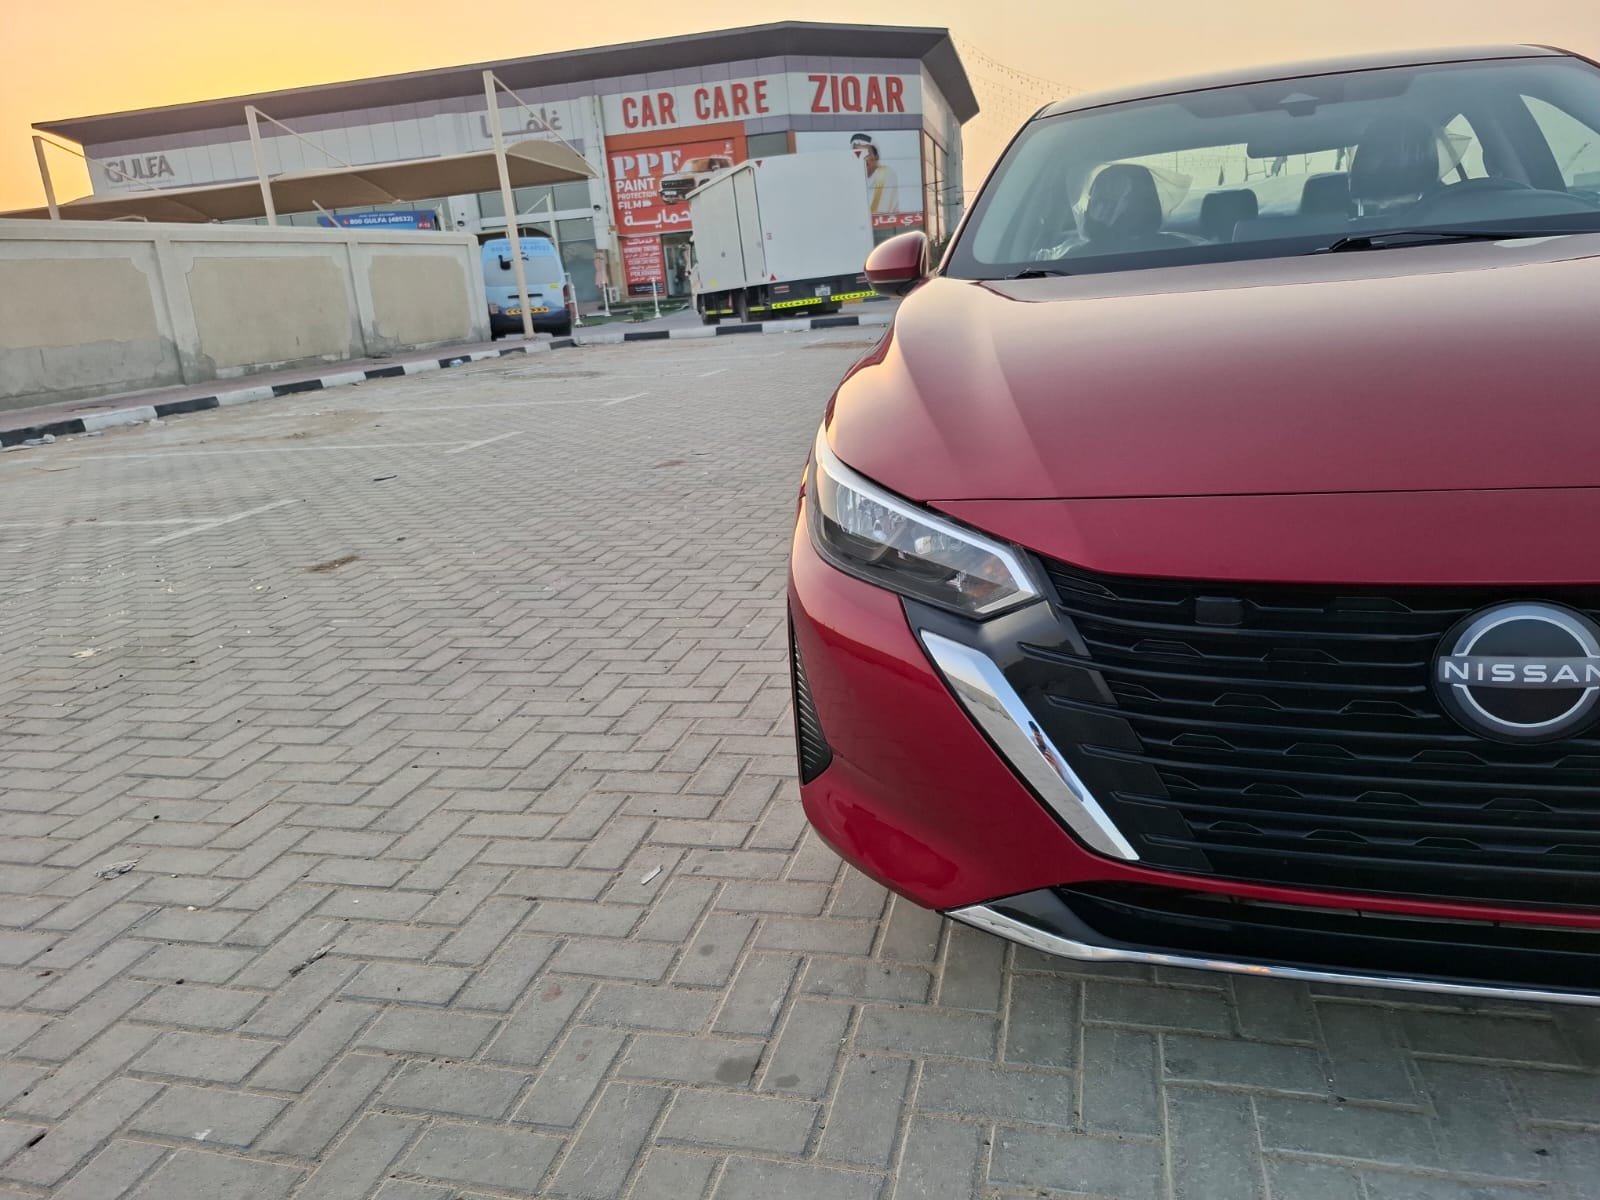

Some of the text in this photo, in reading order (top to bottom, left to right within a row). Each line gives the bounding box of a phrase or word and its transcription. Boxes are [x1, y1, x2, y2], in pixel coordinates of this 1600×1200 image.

[622, 79, 769, 128] CAR CARE
[808, 75, 905, 113] ZIQAR
[104, 155, 175, 183] GULFA
[611, 150, 682, 180] PPF
[615, 177, 655, 193] PAINT
[617, 190, 658, 200] PROTECTION
[618, 199, 642, 210] FILM
[1444, 661, 1600, 683] NISSAN
